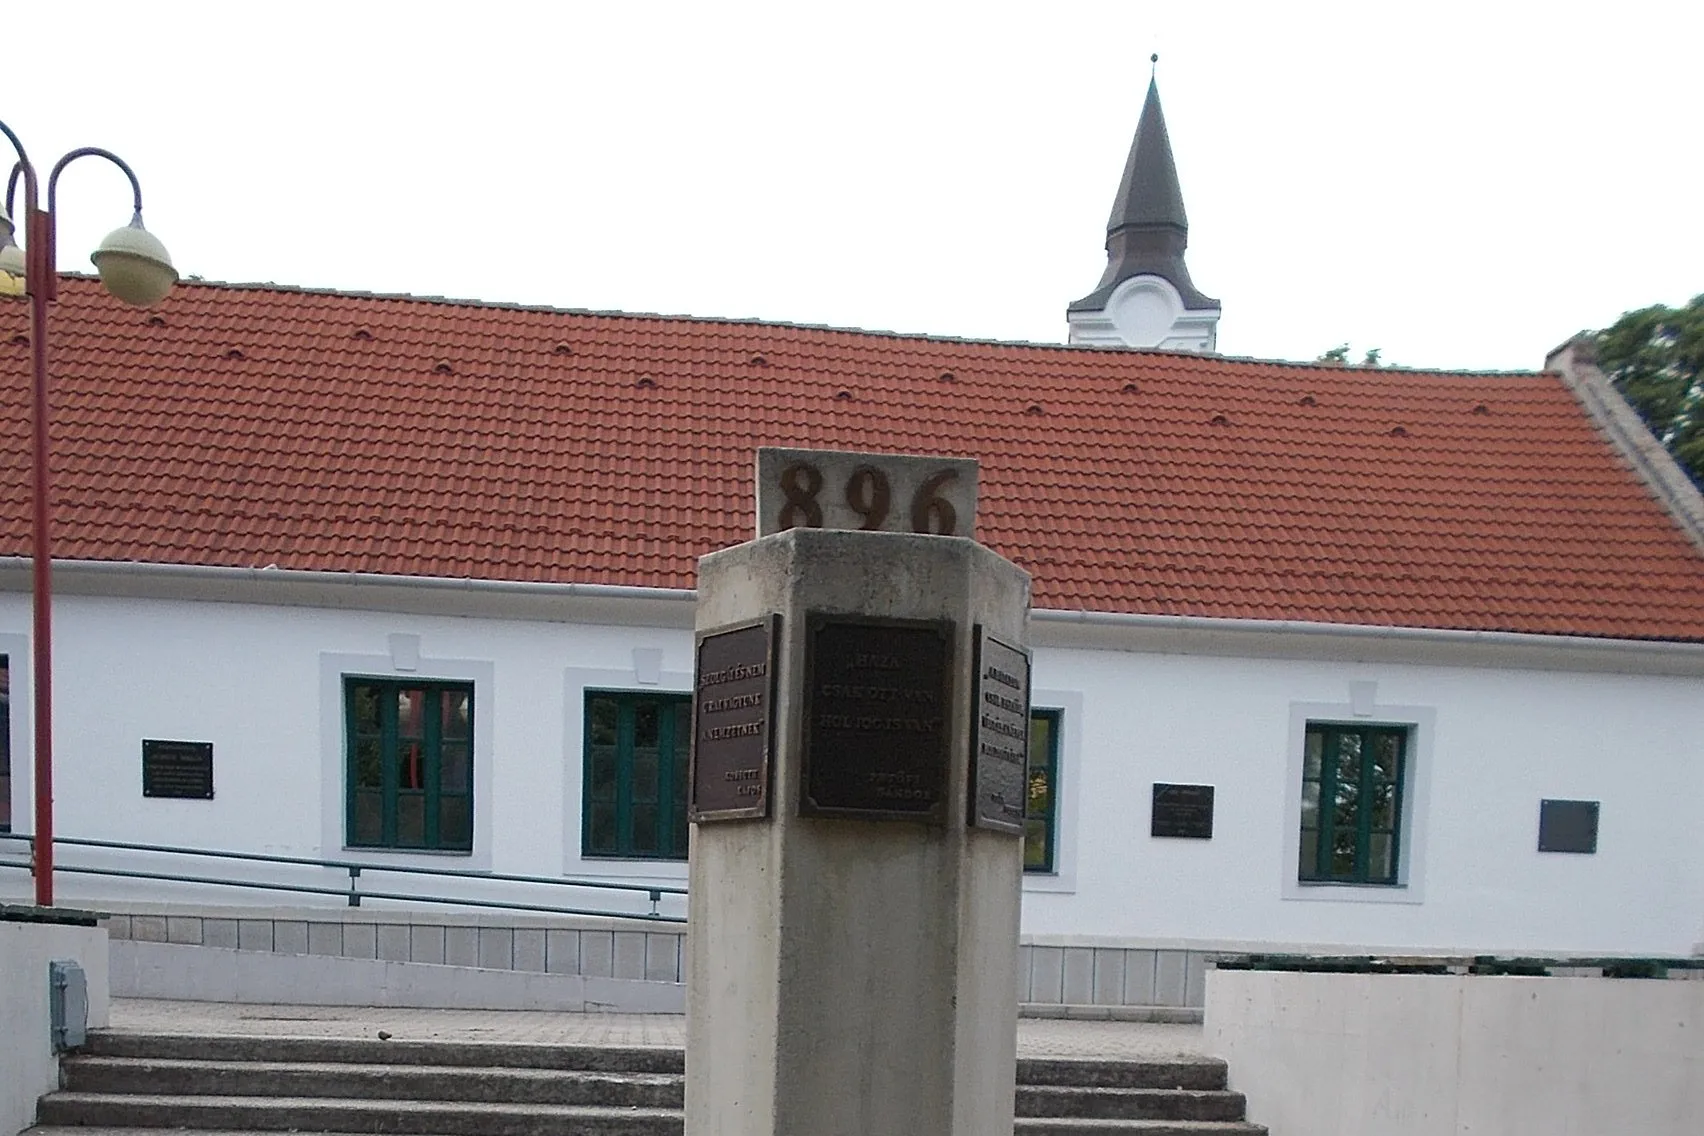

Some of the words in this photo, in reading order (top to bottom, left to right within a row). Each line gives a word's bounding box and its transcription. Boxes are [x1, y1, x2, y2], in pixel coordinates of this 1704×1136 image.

[779, 459, 959, 535] 896
[868, 686, 898, 699] OTT
[820, 714, 854, 729] HOL
[886, 717, 901, 730] IS
